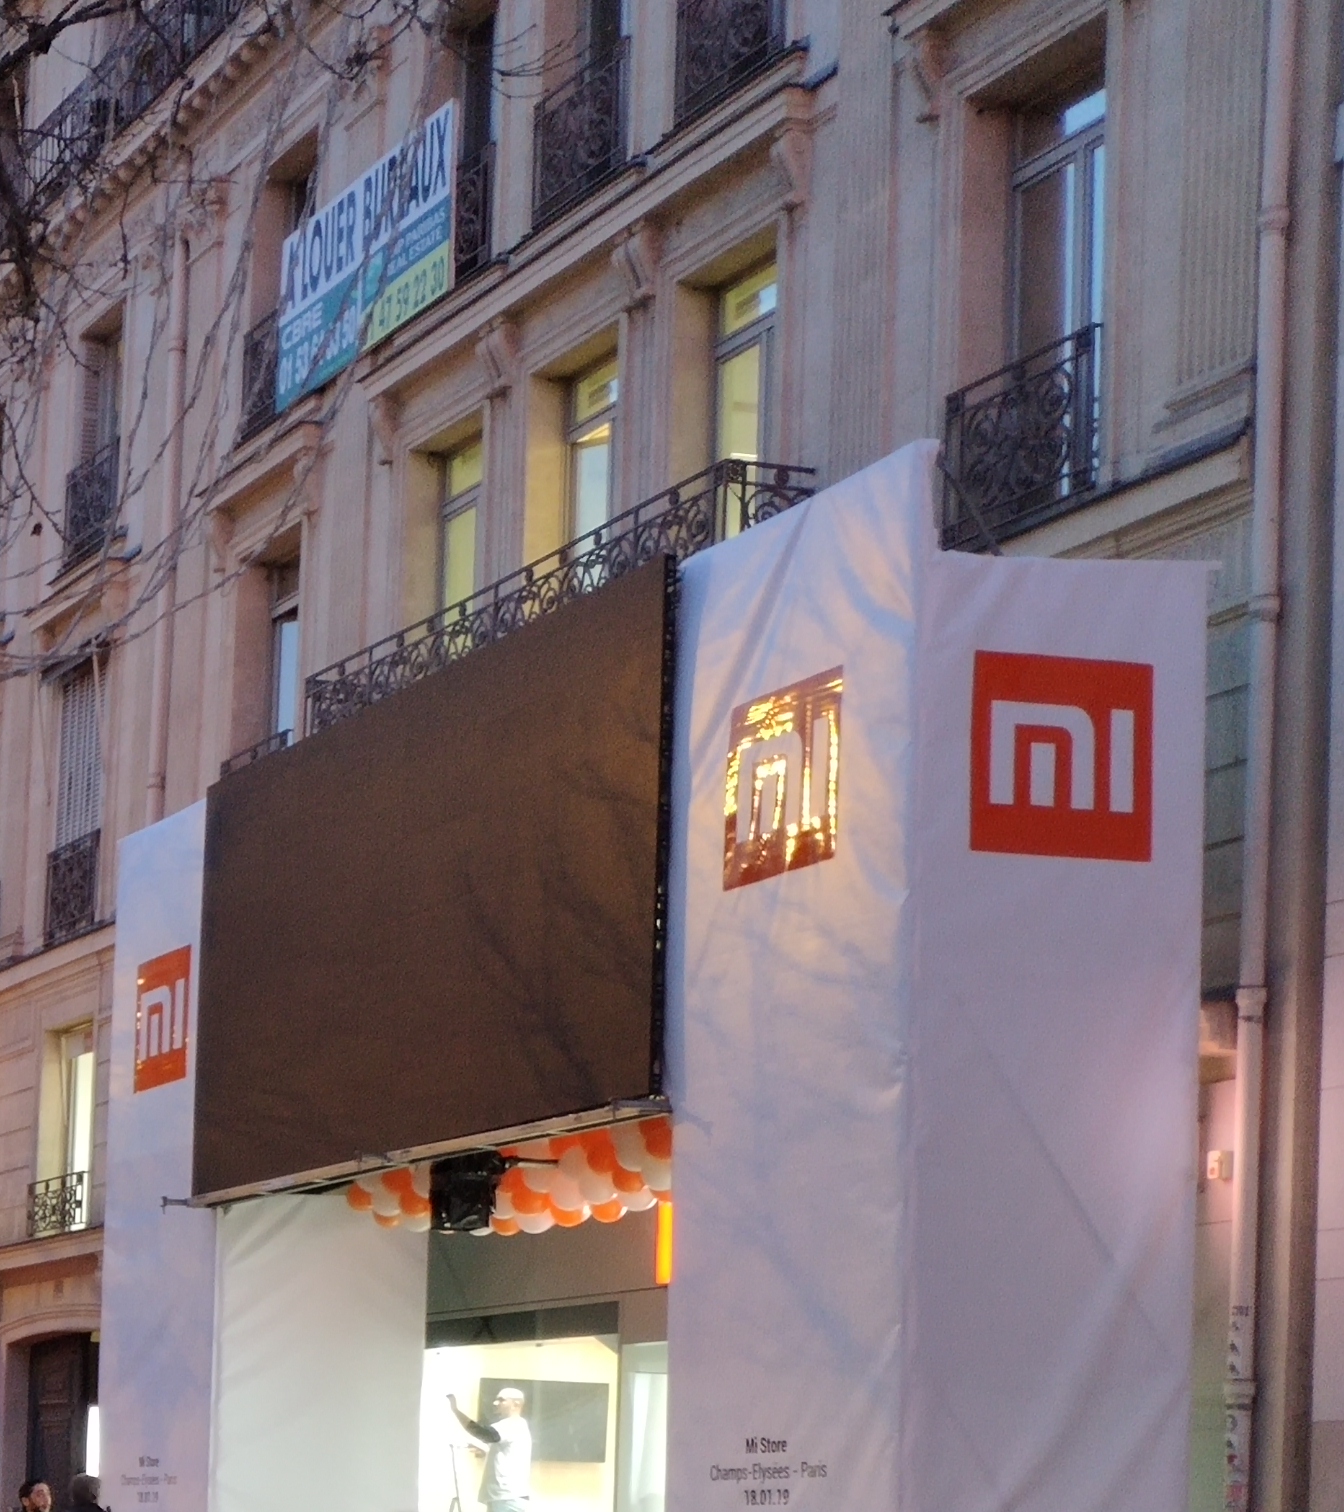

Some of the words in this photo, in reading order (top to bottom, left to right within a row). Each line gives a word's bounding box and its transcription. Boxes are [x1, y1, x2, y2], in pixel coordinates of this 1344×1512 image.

[301, 190, 357, 300] LOUER
[281, 302, 324, 350] CBRE
[745, 1437, 758, 1454] Mi
[760, 1437, 788, 1453] Store
[800, 1460, 828, 1479] Paris
[744, 1488, 790, 1506] 18.01.19
